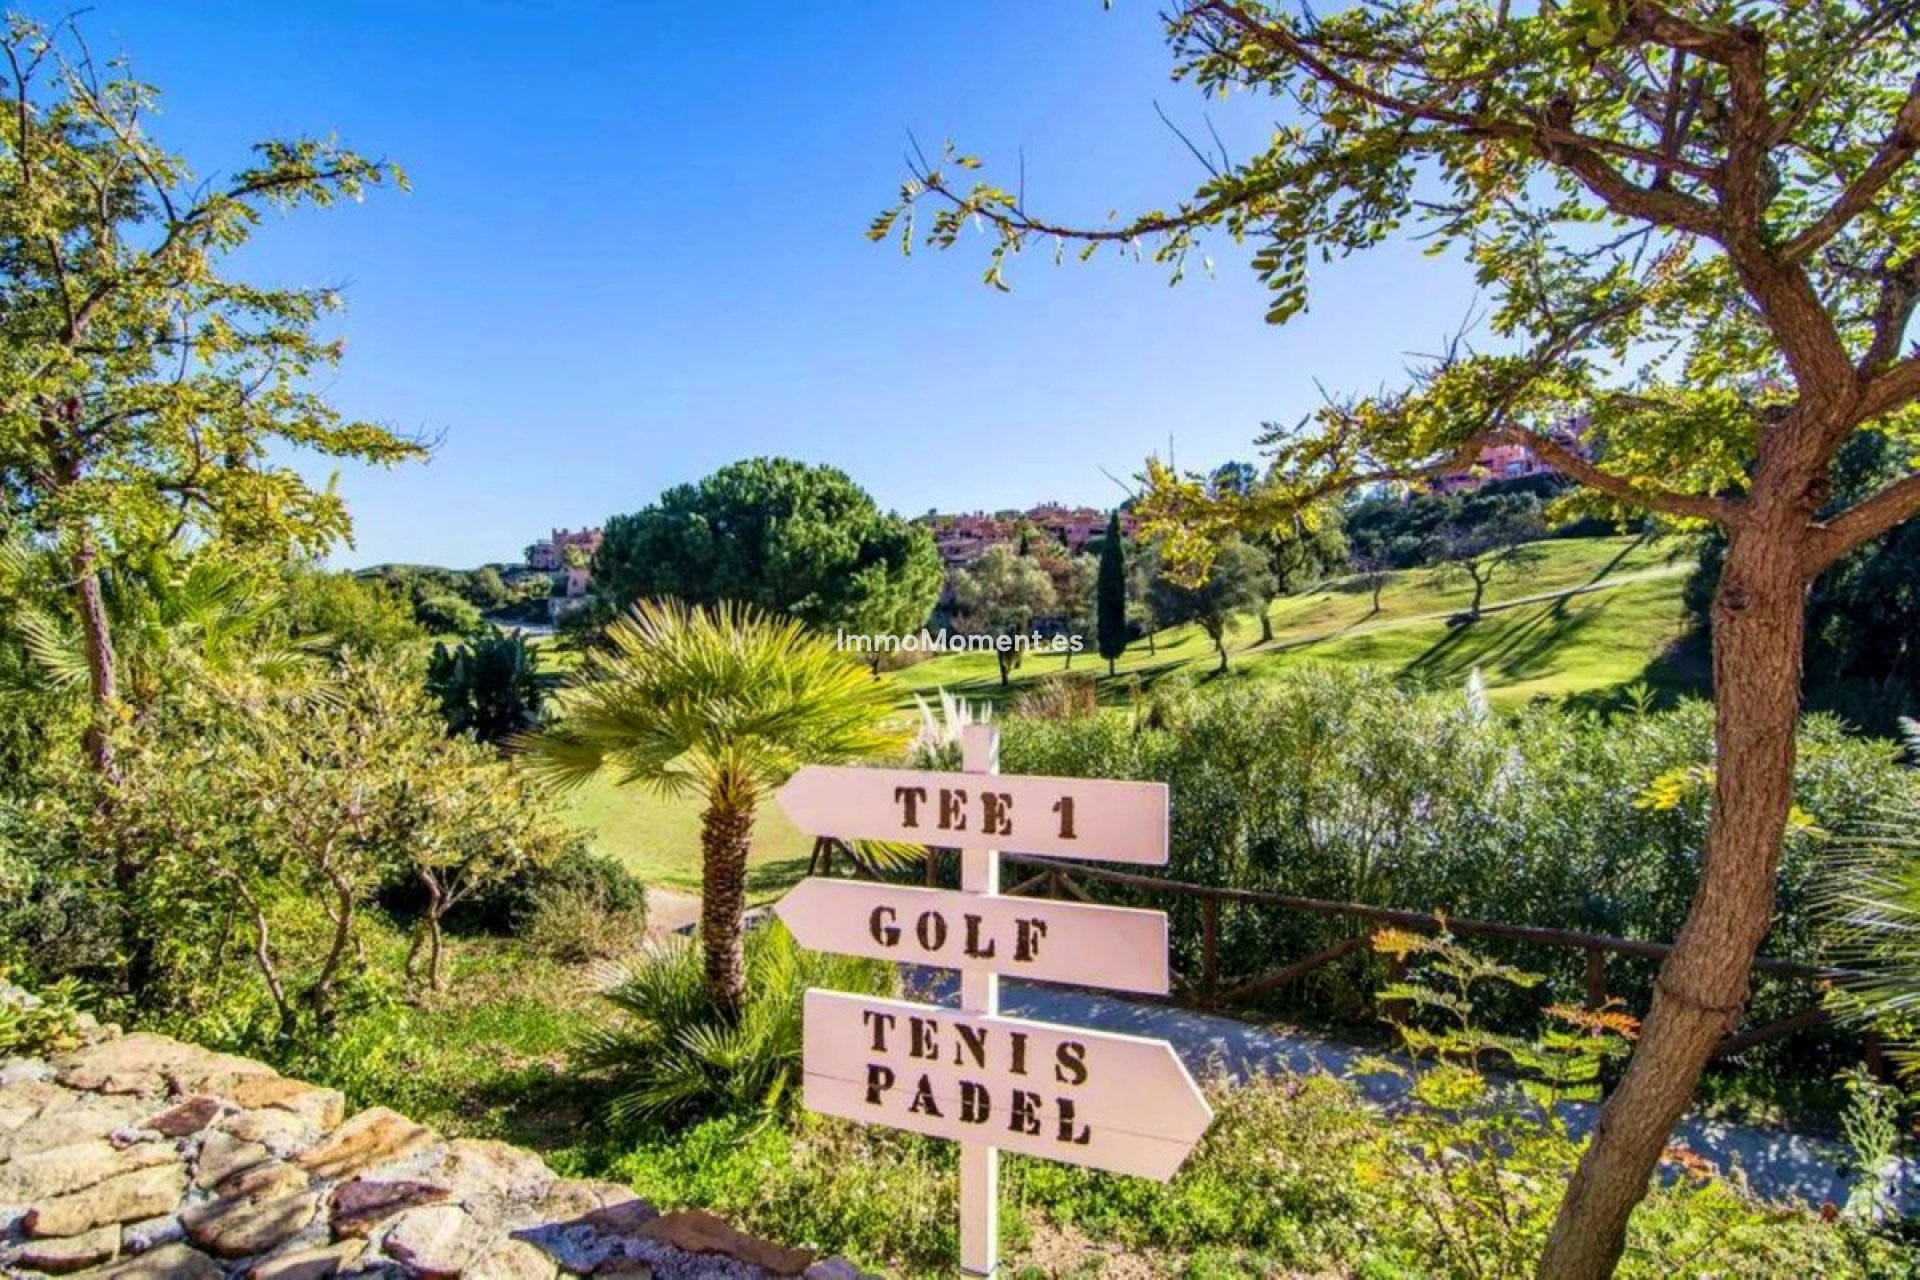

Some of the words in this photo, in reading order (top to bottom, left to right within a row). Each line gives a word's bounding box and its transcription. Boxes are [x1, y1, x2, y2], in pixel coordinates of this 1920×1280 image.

[895, 787, 1012, 836] TEE
[1052, 796, 1077, 839] 1
[869, 906, 1047, 962] GOLF
[863, 1010, 1088, 1086] TENIS
[864, 1064, 1091, 1146] PADEL
